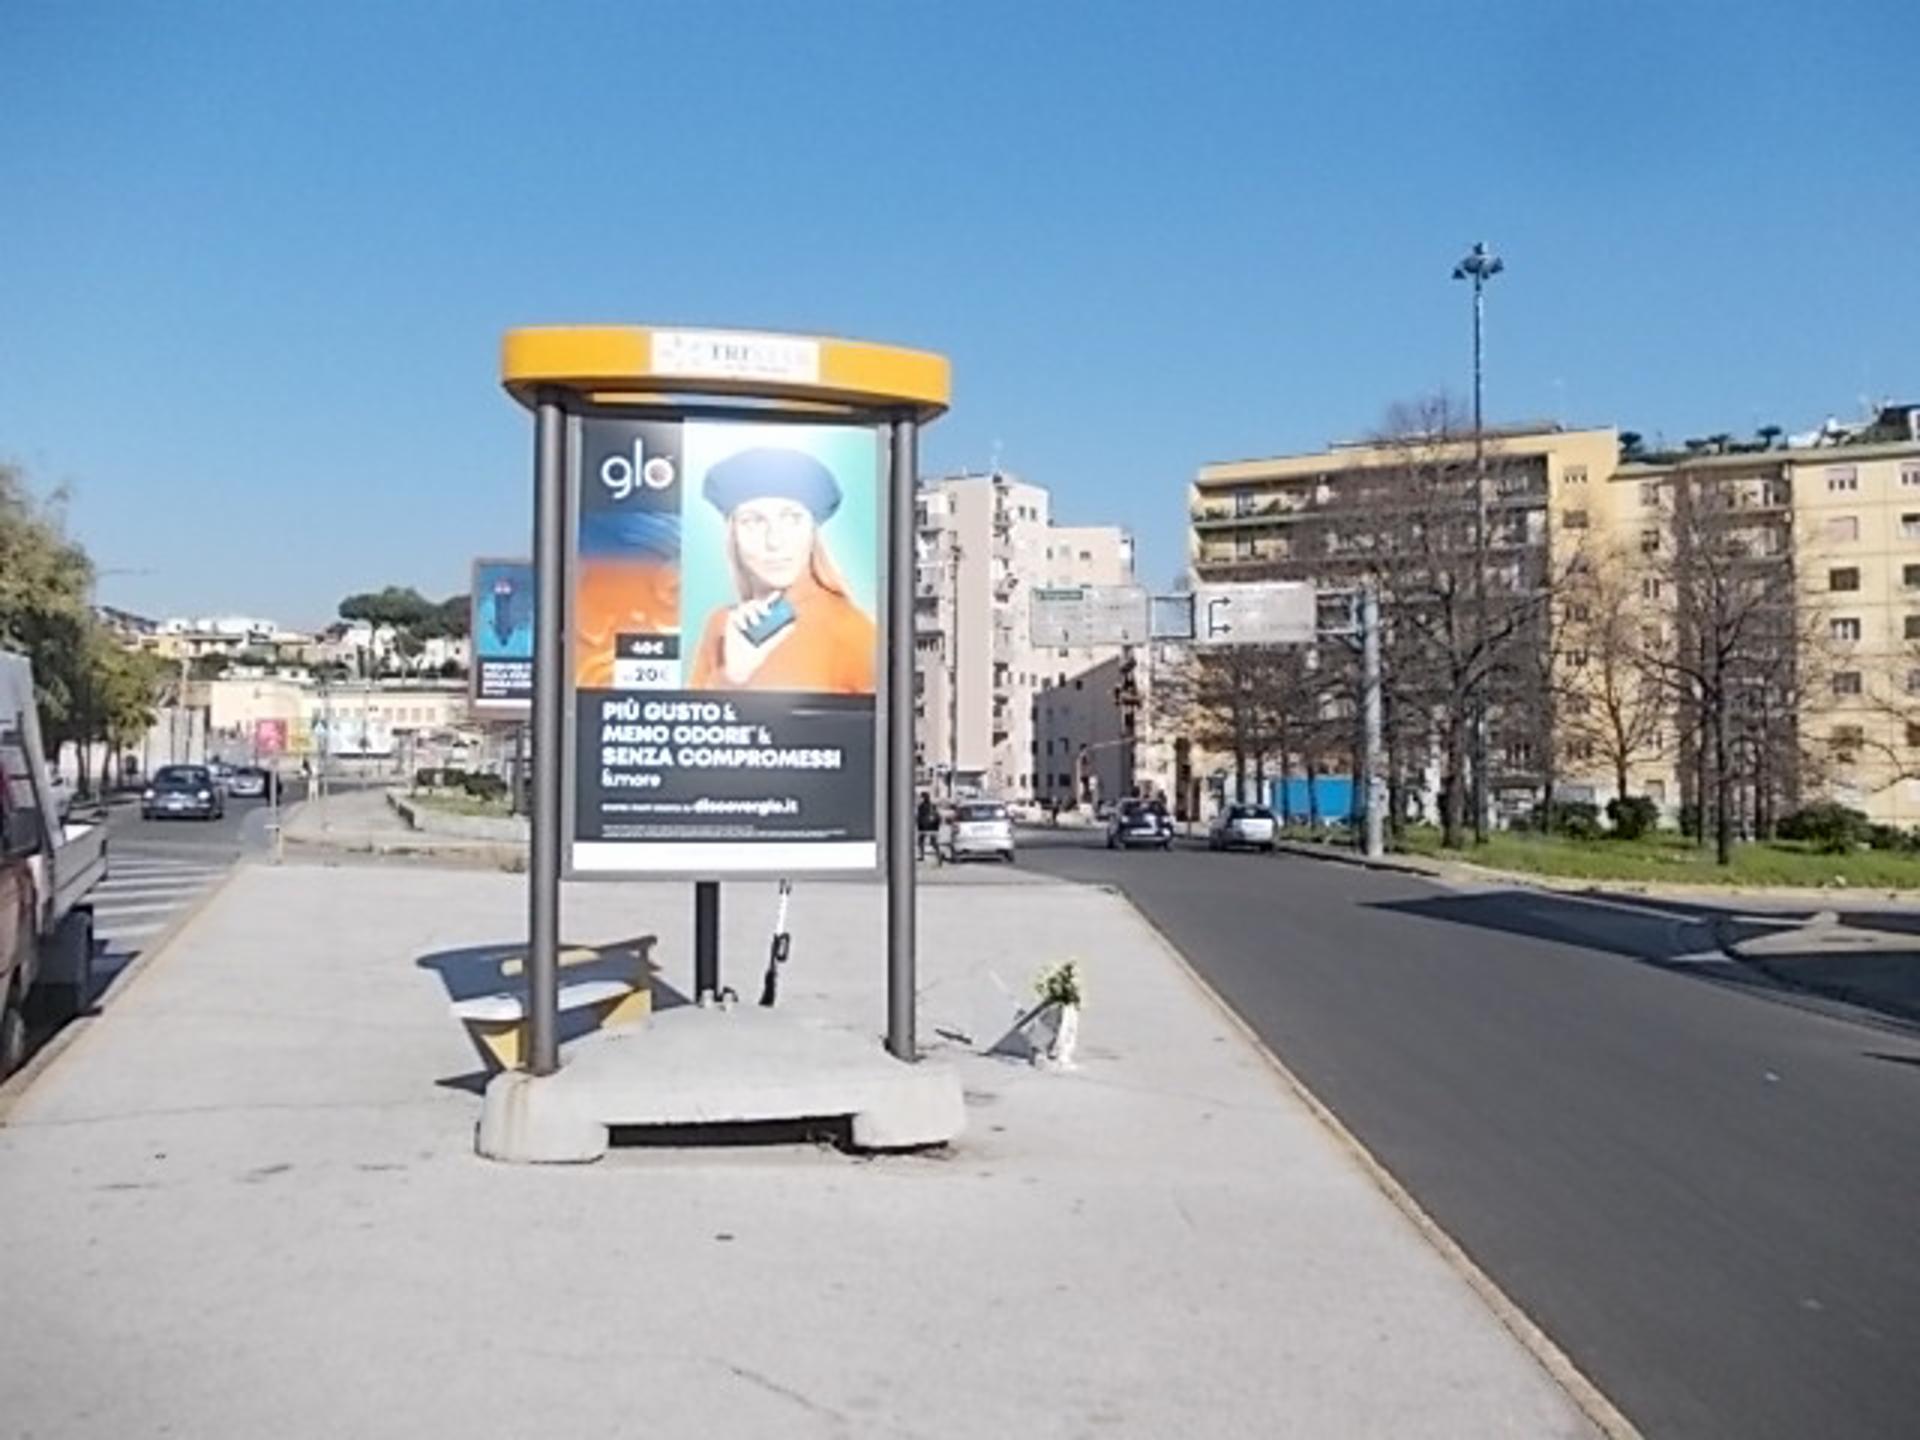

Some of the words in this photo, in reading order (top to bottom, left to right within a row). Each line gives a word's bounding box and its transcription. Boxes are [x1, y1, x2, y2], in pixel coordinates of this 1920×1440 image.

[601, 437, 674, 499] glo
[602, 698, 640, 721] PIÙ
[643, 701, 721, 722] GUSTO
[602, 725, 670, 743] MENO
[602, 747, 674, 766] SENZA
[677, 749, 841, 768] COMPROMESSI
